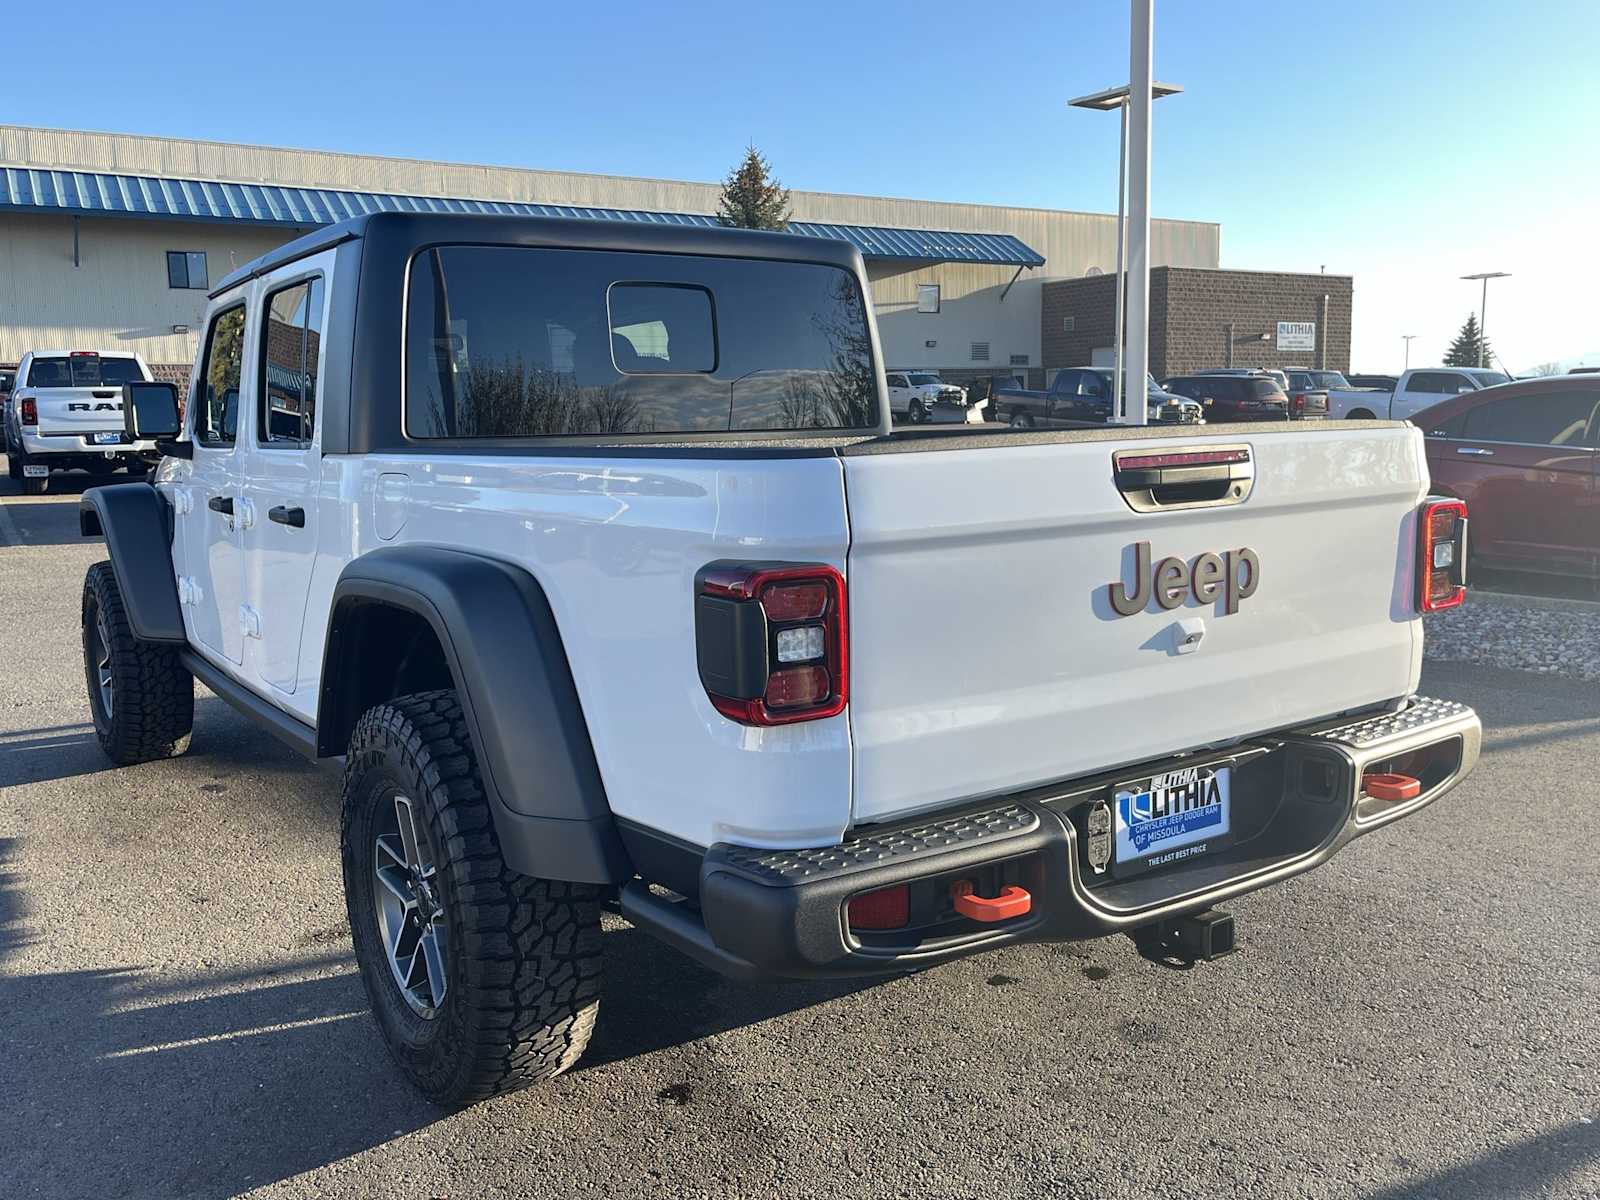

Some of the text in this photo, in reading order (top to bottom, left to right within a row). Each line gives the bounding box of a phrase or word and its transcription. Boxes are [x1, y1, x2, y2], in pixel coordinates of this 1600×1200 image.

[1287, 324, 1313, 334] LITHIA
[1108, 541, 1260, 616] Jeep
[1162, 768, 1198, 787] LITHIA
[1152, 778, 1221, 819] LITHIA
[1135, 806, 1218, 833] CHRYSLER JEEP DODGE RAM
[1135, 823, 1186, 845] OF MISSOULA
[1148, 844, 1207, 866] THE LAST BEST PRICE
